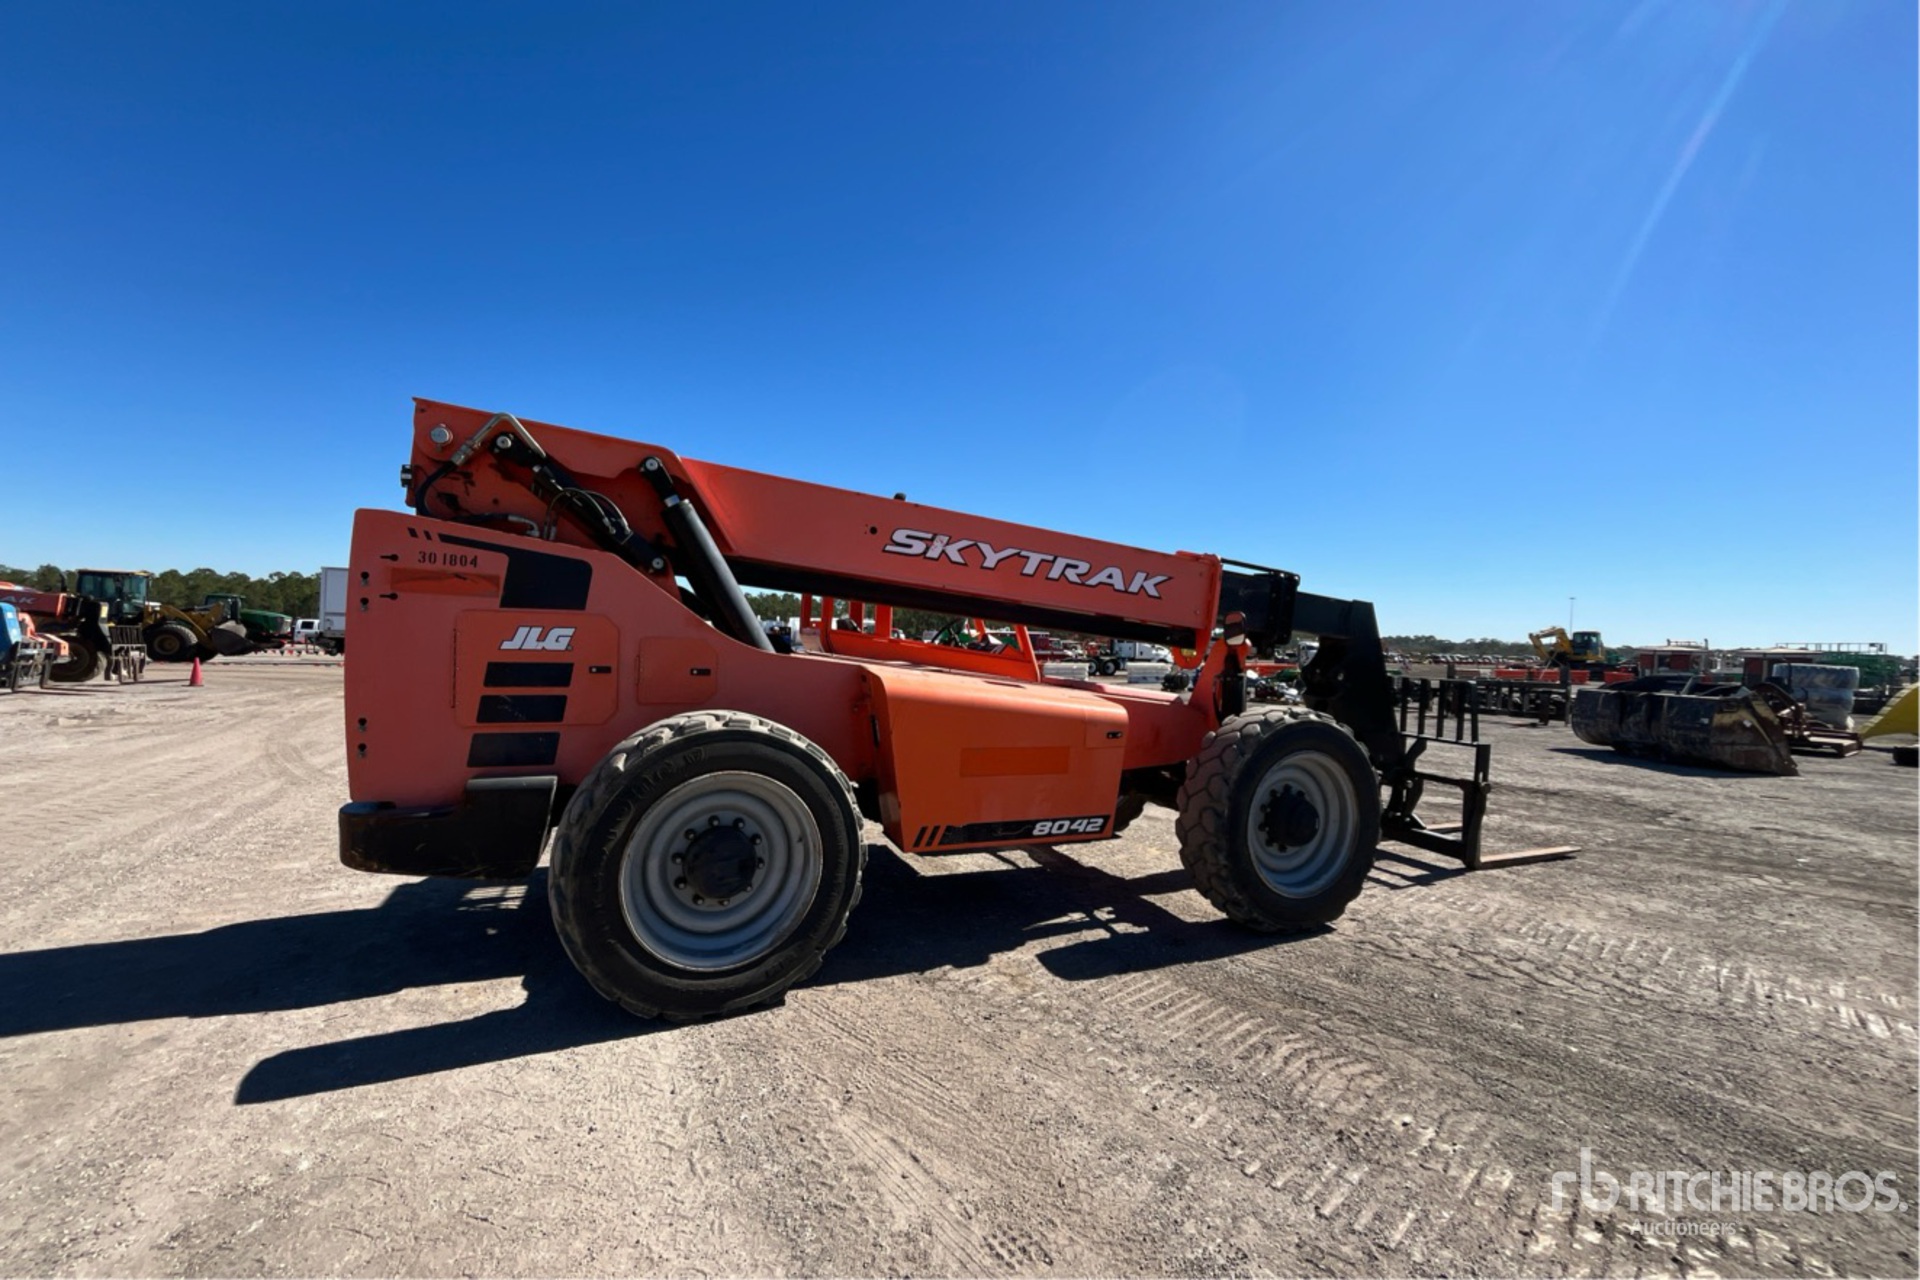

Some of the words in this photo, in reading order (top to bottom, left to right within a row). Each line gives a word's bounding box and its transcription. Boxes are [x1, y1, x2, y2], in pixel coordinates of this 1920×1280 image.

[883, 528, 1171, 599] SKYTRAK
[499, 625, 575, 650] JLG
[1032, 817, 1104, 836] 8042
